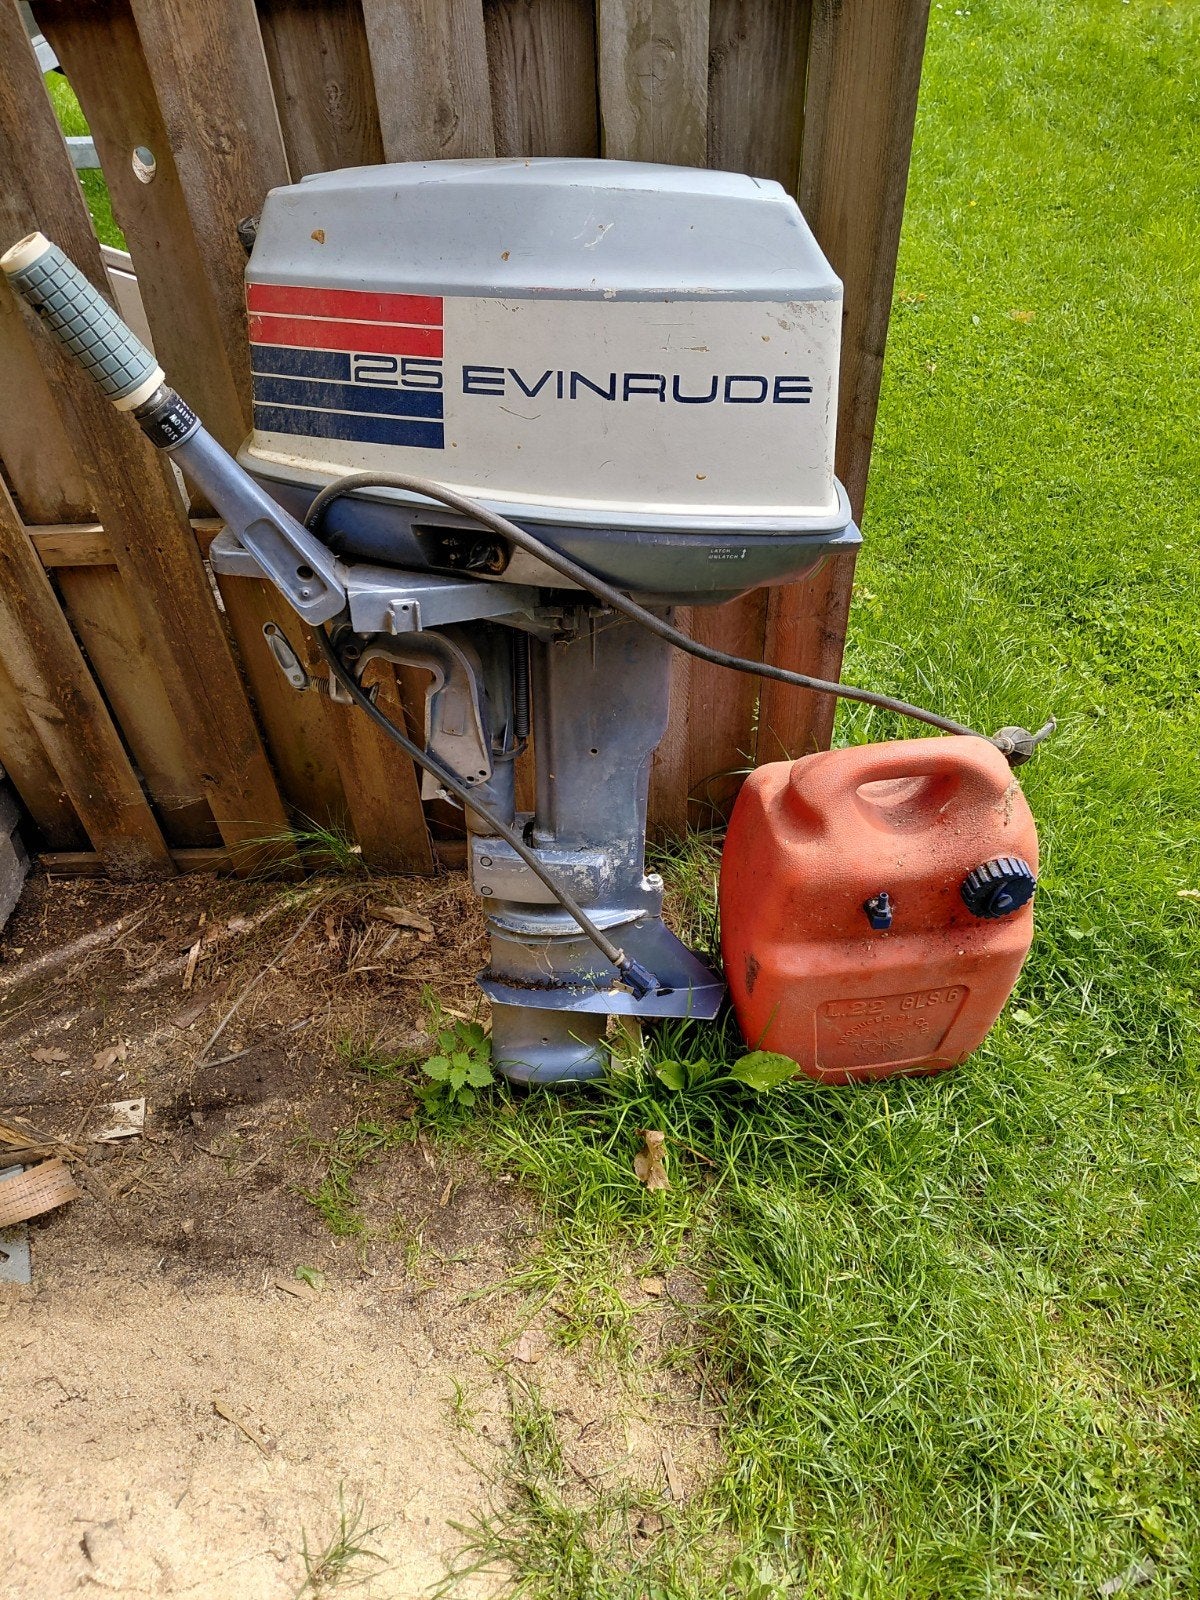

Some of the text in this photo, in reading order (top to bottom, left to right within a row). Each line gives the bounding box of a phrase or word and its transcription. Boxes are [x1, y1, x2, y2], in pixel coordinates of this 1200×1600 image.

[353, 354, 443, 389] 25
[462, 365, 813, 404] EVINRUDE
[169, 413, 188, 433] SLOW
[175, 403, 194, 424] SHIFT
[161, 424, 179, 441] STOP
